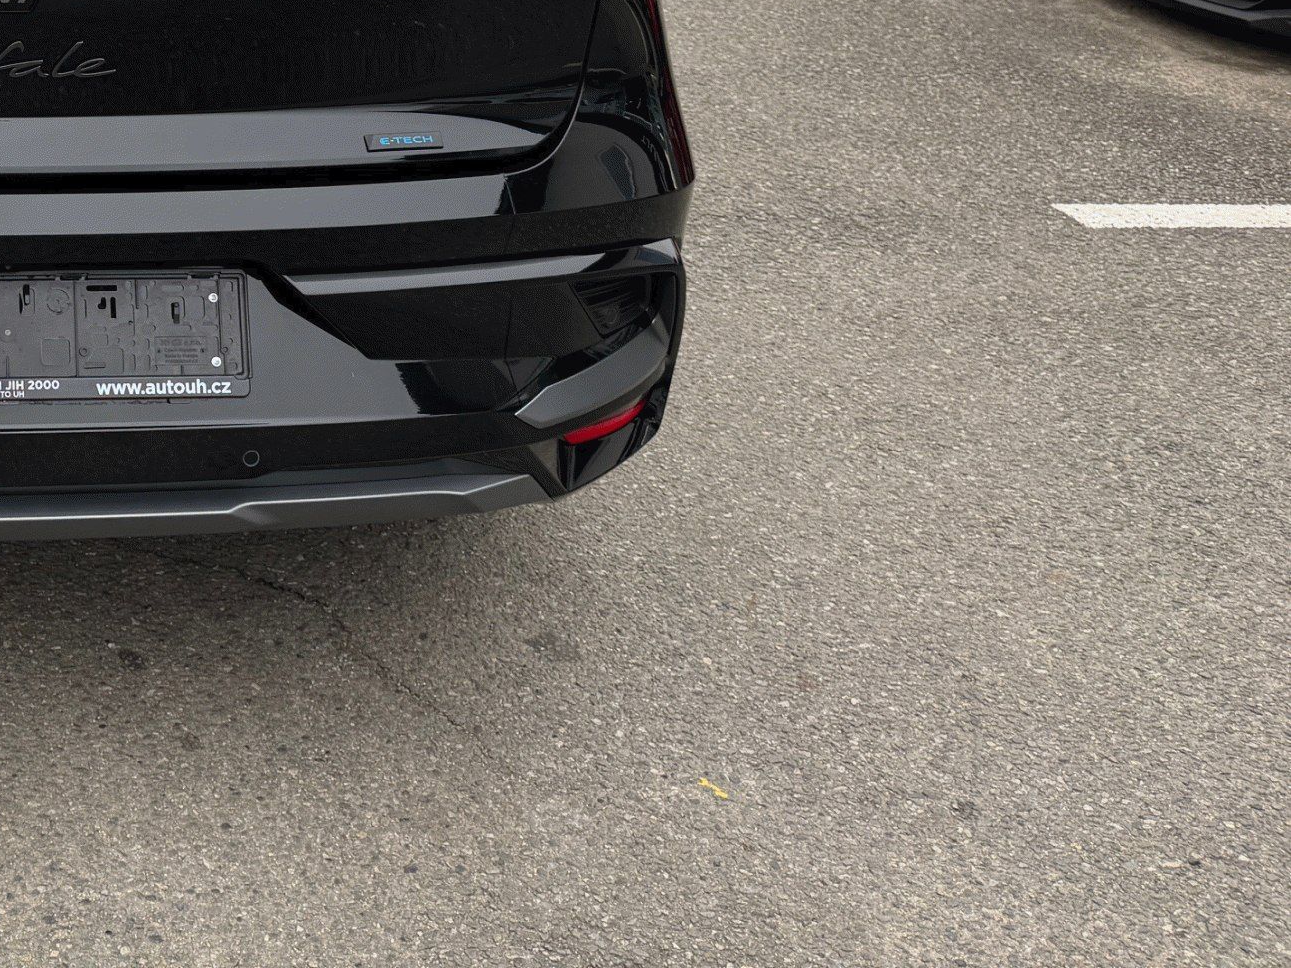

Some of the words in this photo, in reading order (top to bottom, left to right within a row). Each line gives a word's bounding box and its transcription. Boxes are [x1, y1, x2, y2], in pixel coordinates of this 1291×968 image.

[379, 135, 433, 145] E-TECH
[5, 380, 24, 391] JIH
[27, 379, 59, 390] 2000
[96, 379, 232, 396] www.autouh.cz
[13, 390, 25, 398] UH
